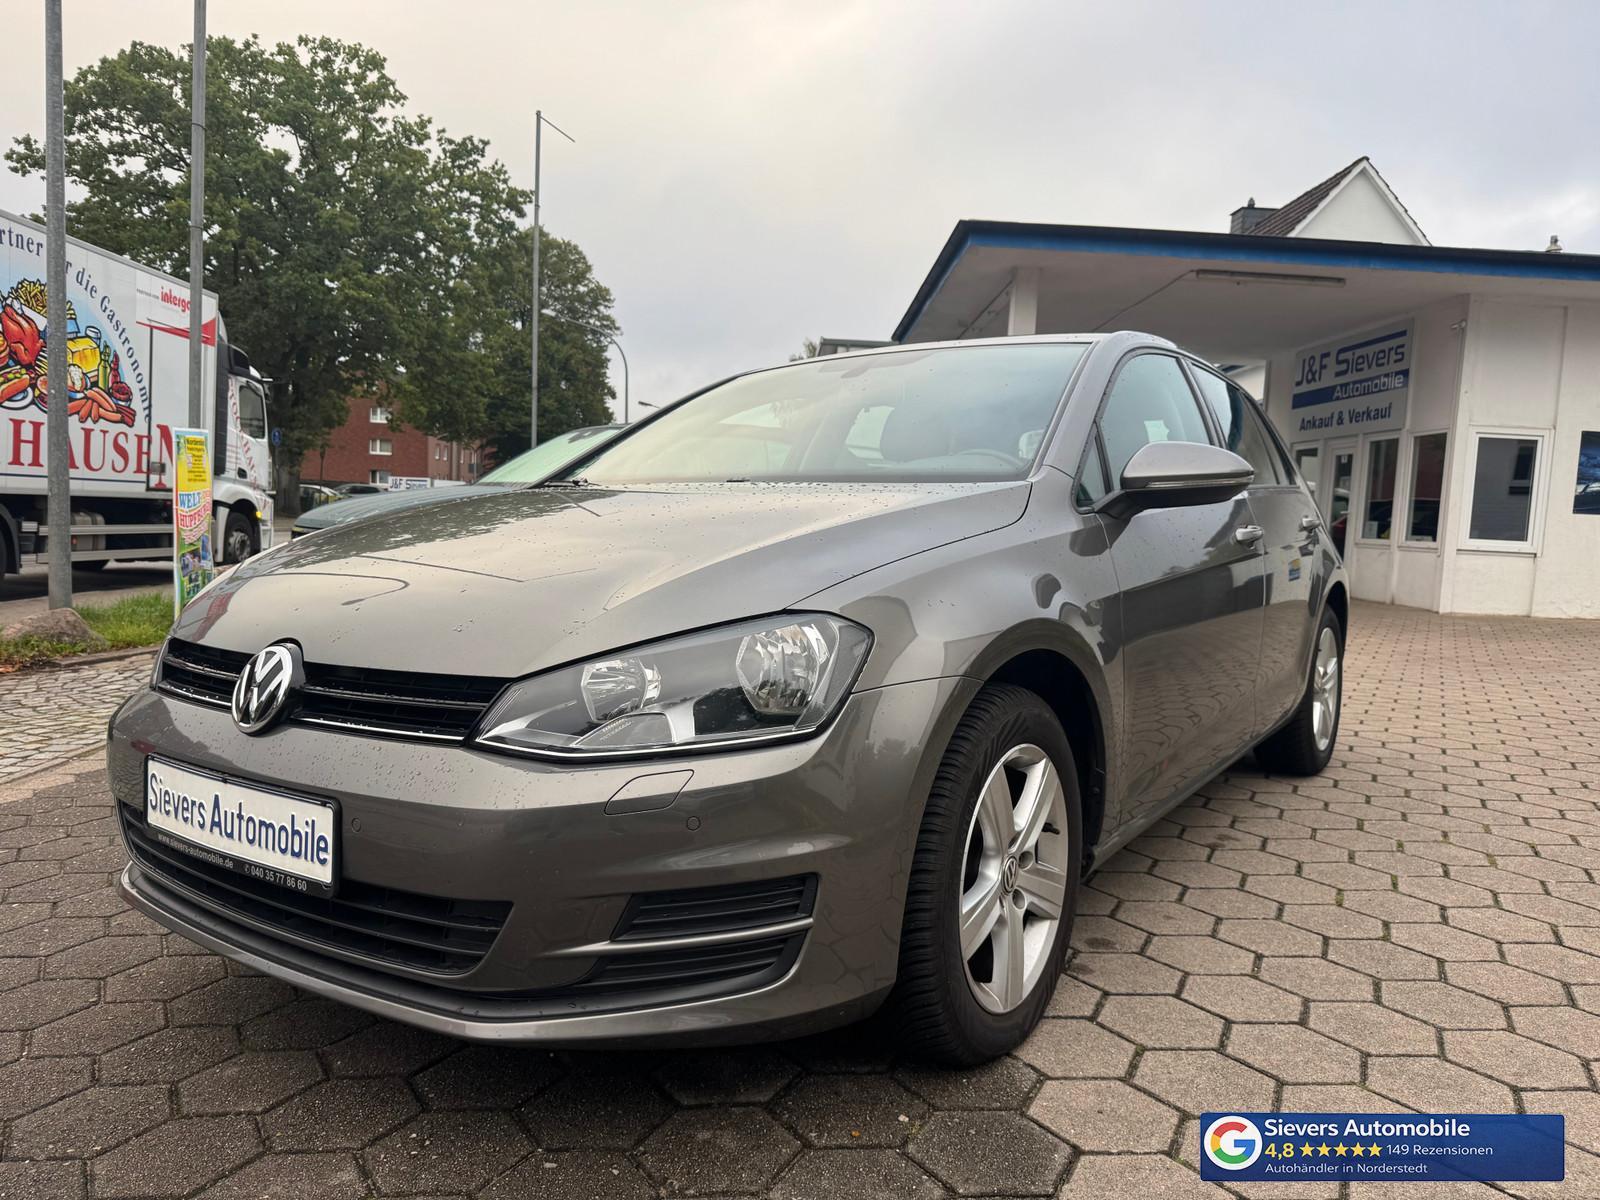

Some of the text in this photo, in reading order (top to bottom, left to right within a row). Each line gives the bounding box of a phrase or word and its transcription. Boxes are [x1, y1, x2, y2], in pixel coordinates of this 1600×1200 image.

[76, 267, 98, 299] die
[1295, 343, 1406, 387] J&F Sievers
[1333, 372, 1404, 400] Automobile
[1299, 402, 1392, 432] Ankauf & Verkauf
[150, 772, 329, 866] Sievers Automobile
[157, 833, 307, 892] www.sievers-automobile.de 040 35 77 86 60
